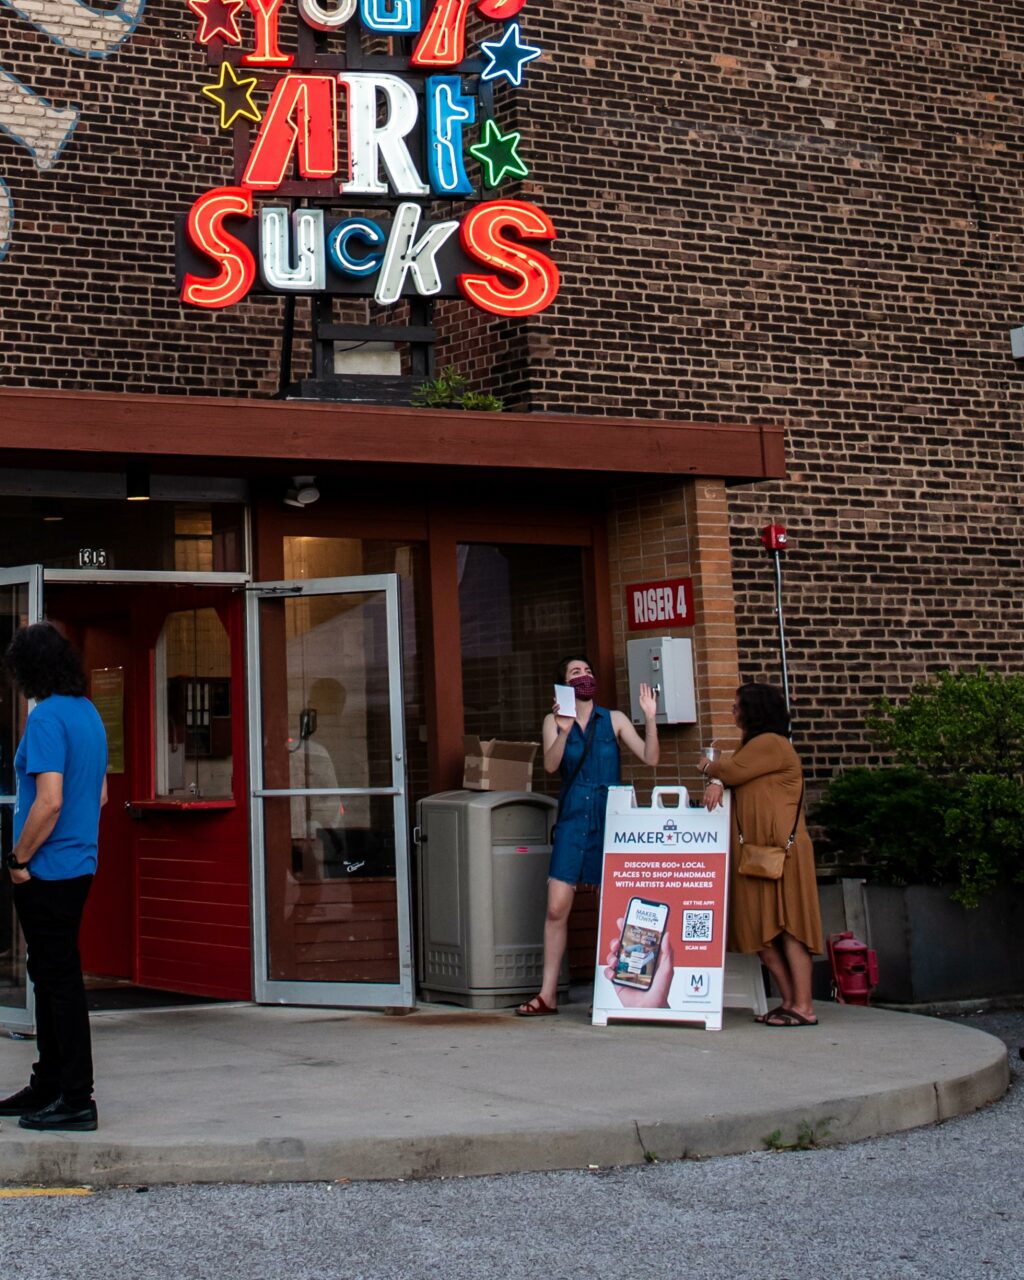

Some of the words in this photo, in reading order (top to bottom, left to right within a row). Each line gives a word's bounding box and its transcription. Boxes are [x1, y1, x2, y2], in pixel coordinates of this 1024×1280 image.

[633, 587, 675, 624] RISER
[676, 585, 687, 618] 4
[614, 831, 664, 844] MAKER
[673, 831, 718, 843] TOWN
[624, 861, 660, 869] DISCOVER
[661, 861, 680, 869] 600+
[682, 861, 706, 869] LOCAL
[636, 914, 654, 924] TOWN
[637, 909, 656, 918] MAKER
[690, 974, 703, 987] M
